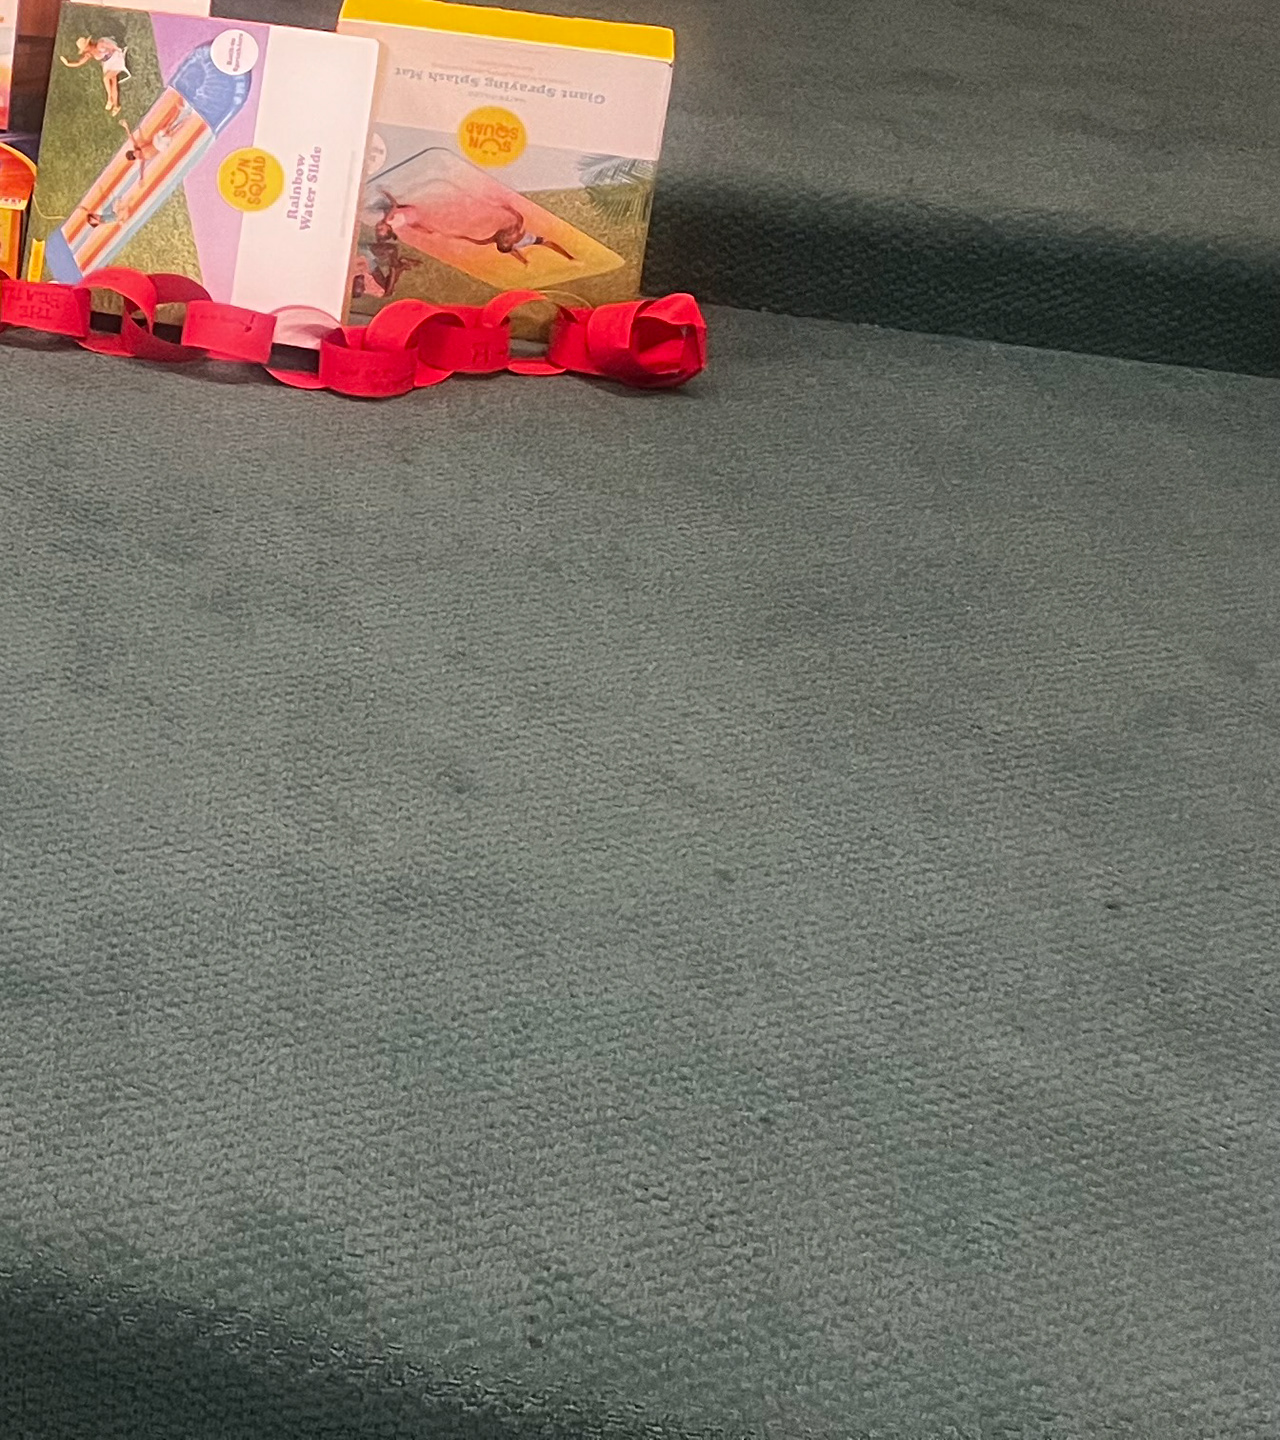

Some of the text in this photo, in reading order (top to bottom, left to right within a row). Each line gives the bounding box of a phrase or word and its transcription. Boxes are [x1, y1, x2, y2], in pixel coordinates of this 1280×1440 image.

[465, 119, 520, 141] SQUAD
[247, 155, 267, 206] SQUAD
[286, 153, 306, 220] Rainbow
[299, 145, 322, 231] Water Slide
